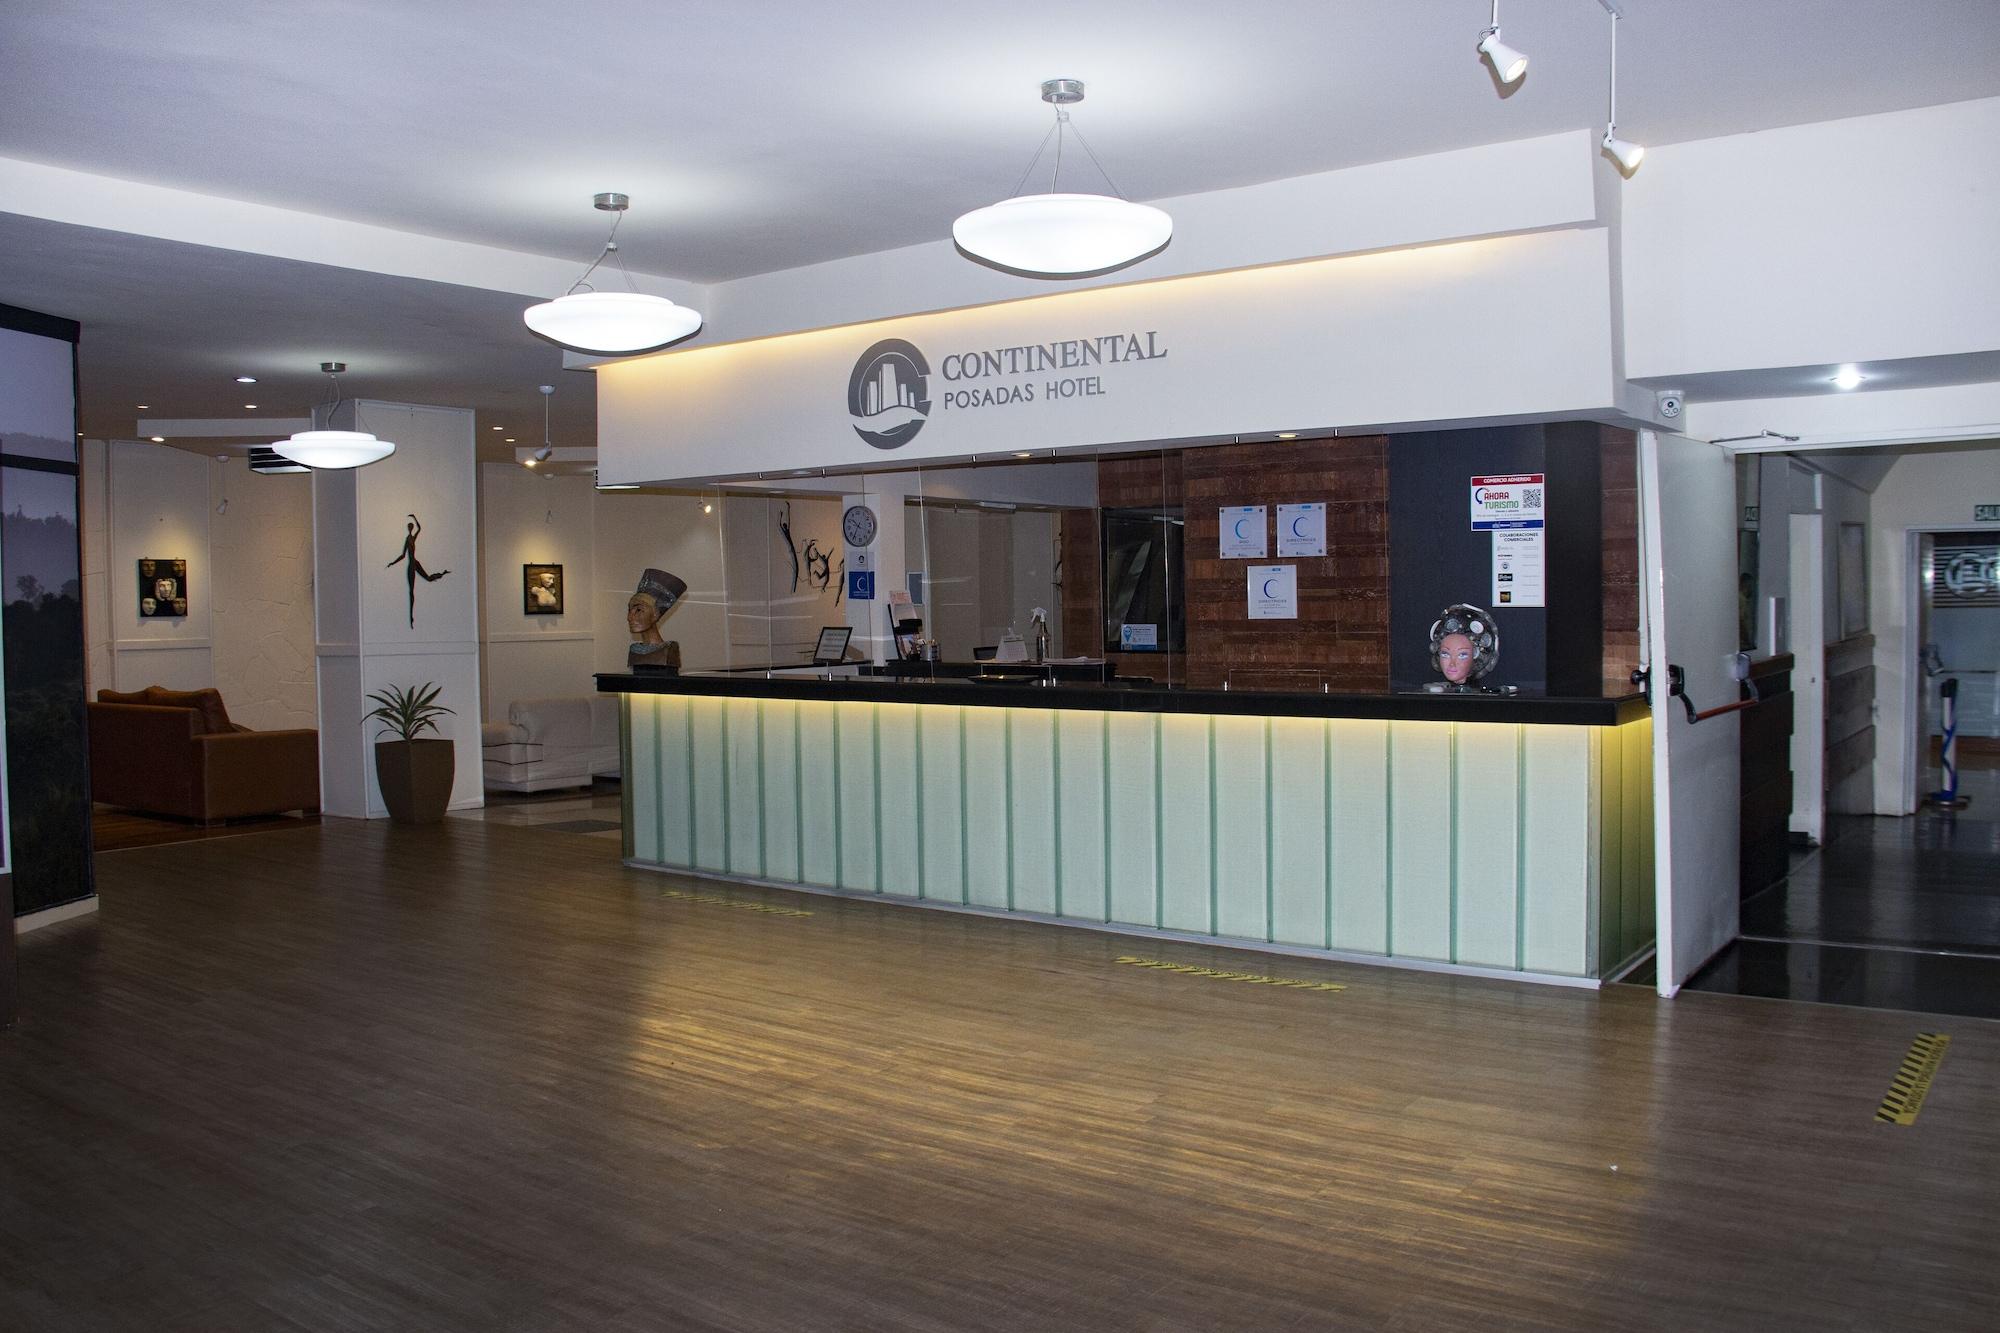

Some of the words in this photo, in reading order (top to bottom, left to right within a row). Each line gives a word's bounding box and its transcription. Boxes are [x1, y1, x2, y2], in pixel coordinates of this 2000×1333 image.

[942, 331, 1168, 381] CONTINENTAL
[944, 383, 1034, 410] POSADAS
[1046, 376, 1106, 401] HOTEL
[1484, 492, 1509, 500] AHORA
[1484, 501, 1519, 509] TURISMO
